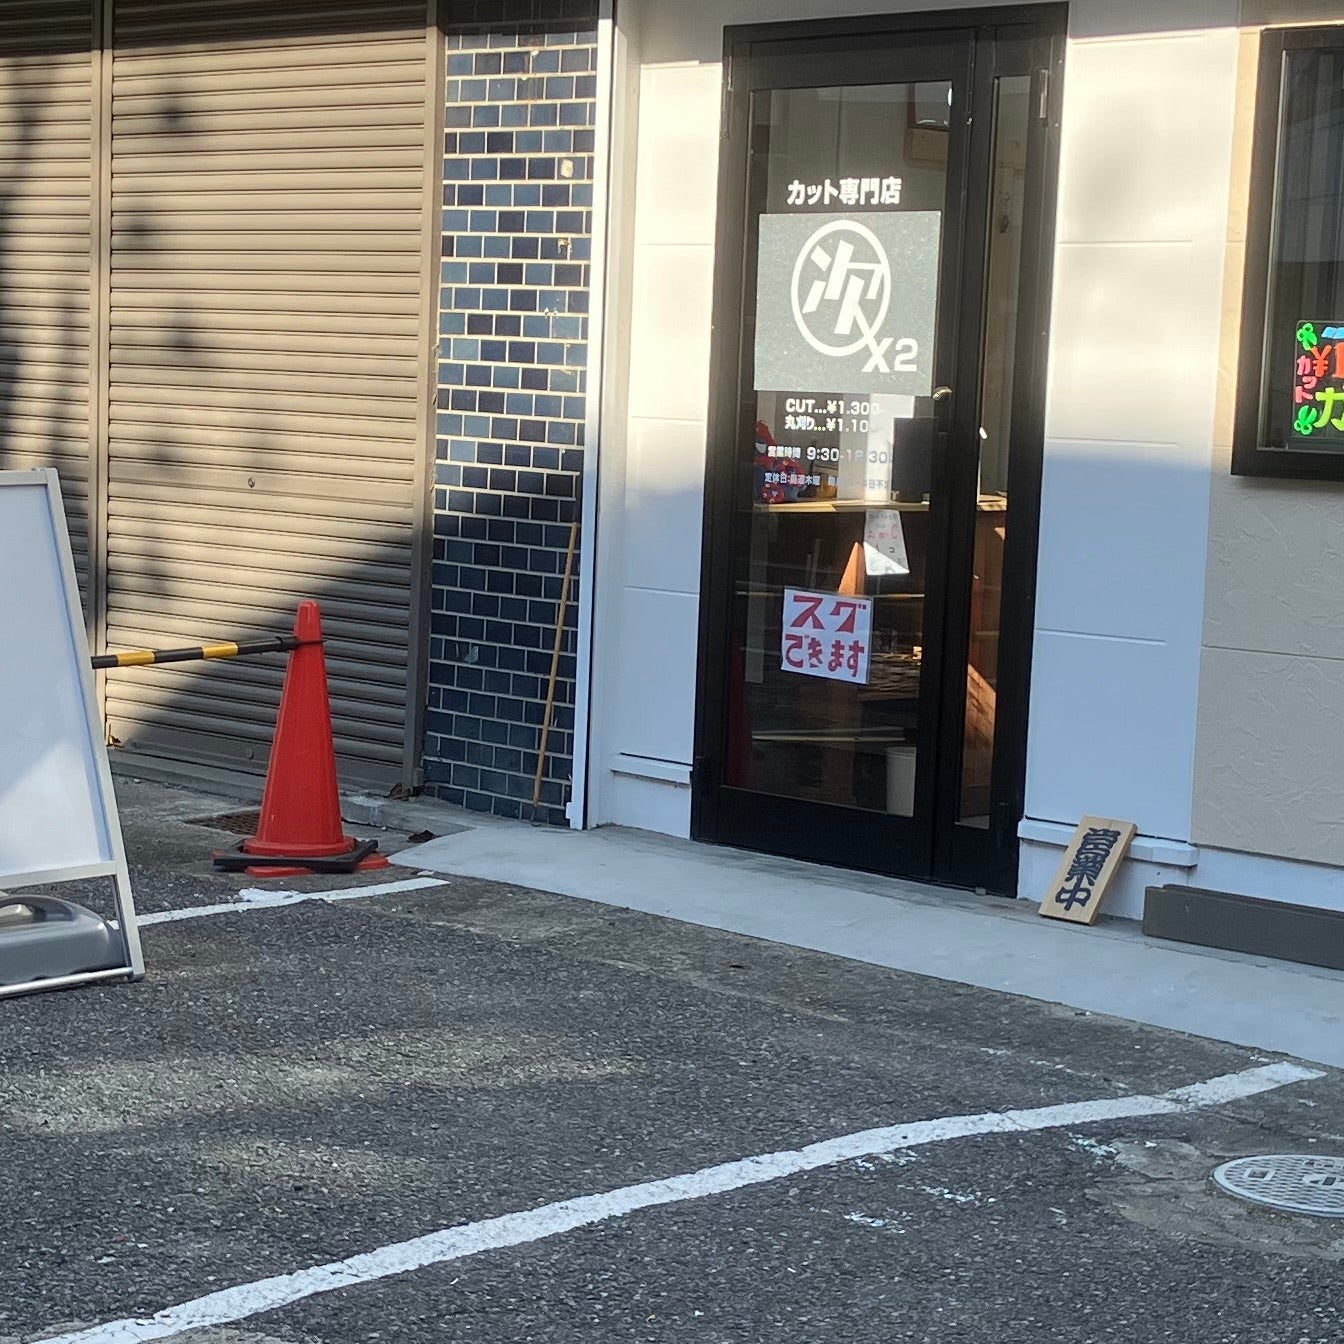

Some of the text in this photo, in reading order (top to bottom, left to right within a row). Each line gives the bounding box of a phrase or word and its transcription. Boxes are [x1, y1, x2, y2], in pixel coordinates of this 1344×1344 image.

[787, 177, 903, 205] カット専門店
[1295, 355, 1318, 403] カット
[790, 595, 867, 633] スグ
[785, 634, 864, 677] できます
[1055, 827, 1121, 911] 営業中
